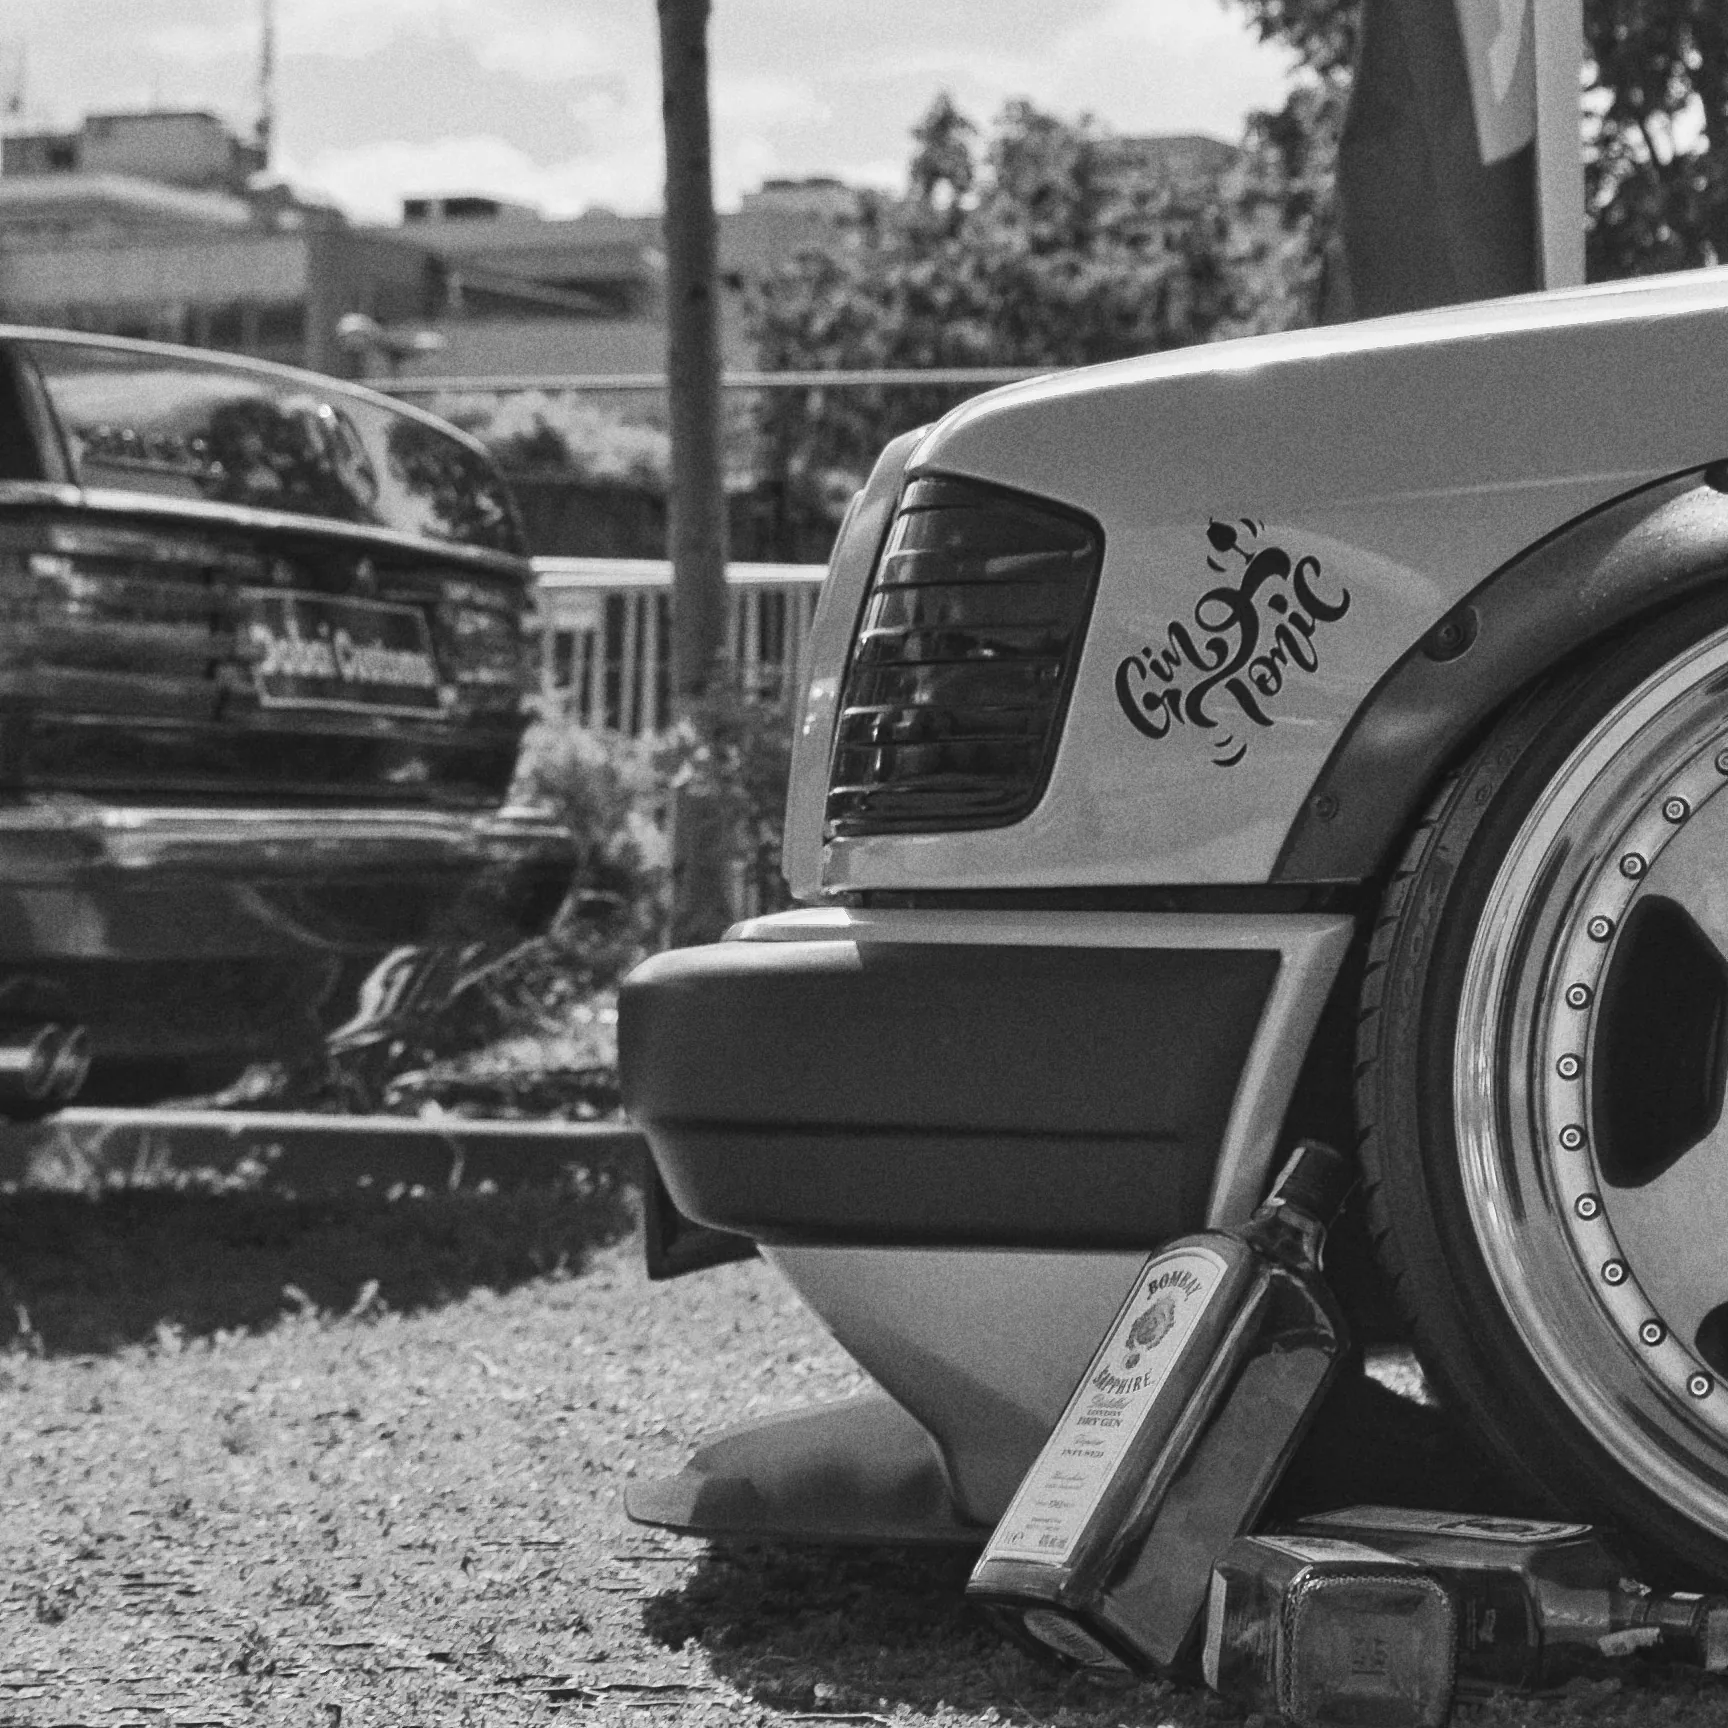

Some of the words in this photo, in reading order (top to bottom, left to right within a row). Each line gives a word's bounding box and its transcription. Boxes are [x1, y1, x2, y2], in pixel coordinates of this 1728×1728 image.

[1115, 621, 1229, 740] Gin
[1224, 555, 1351, 727] Tonic
[1146, 1269, 1203, 1302] BOMBAY
[1092, 1363, 1153, 1395] SAPPHIRE
